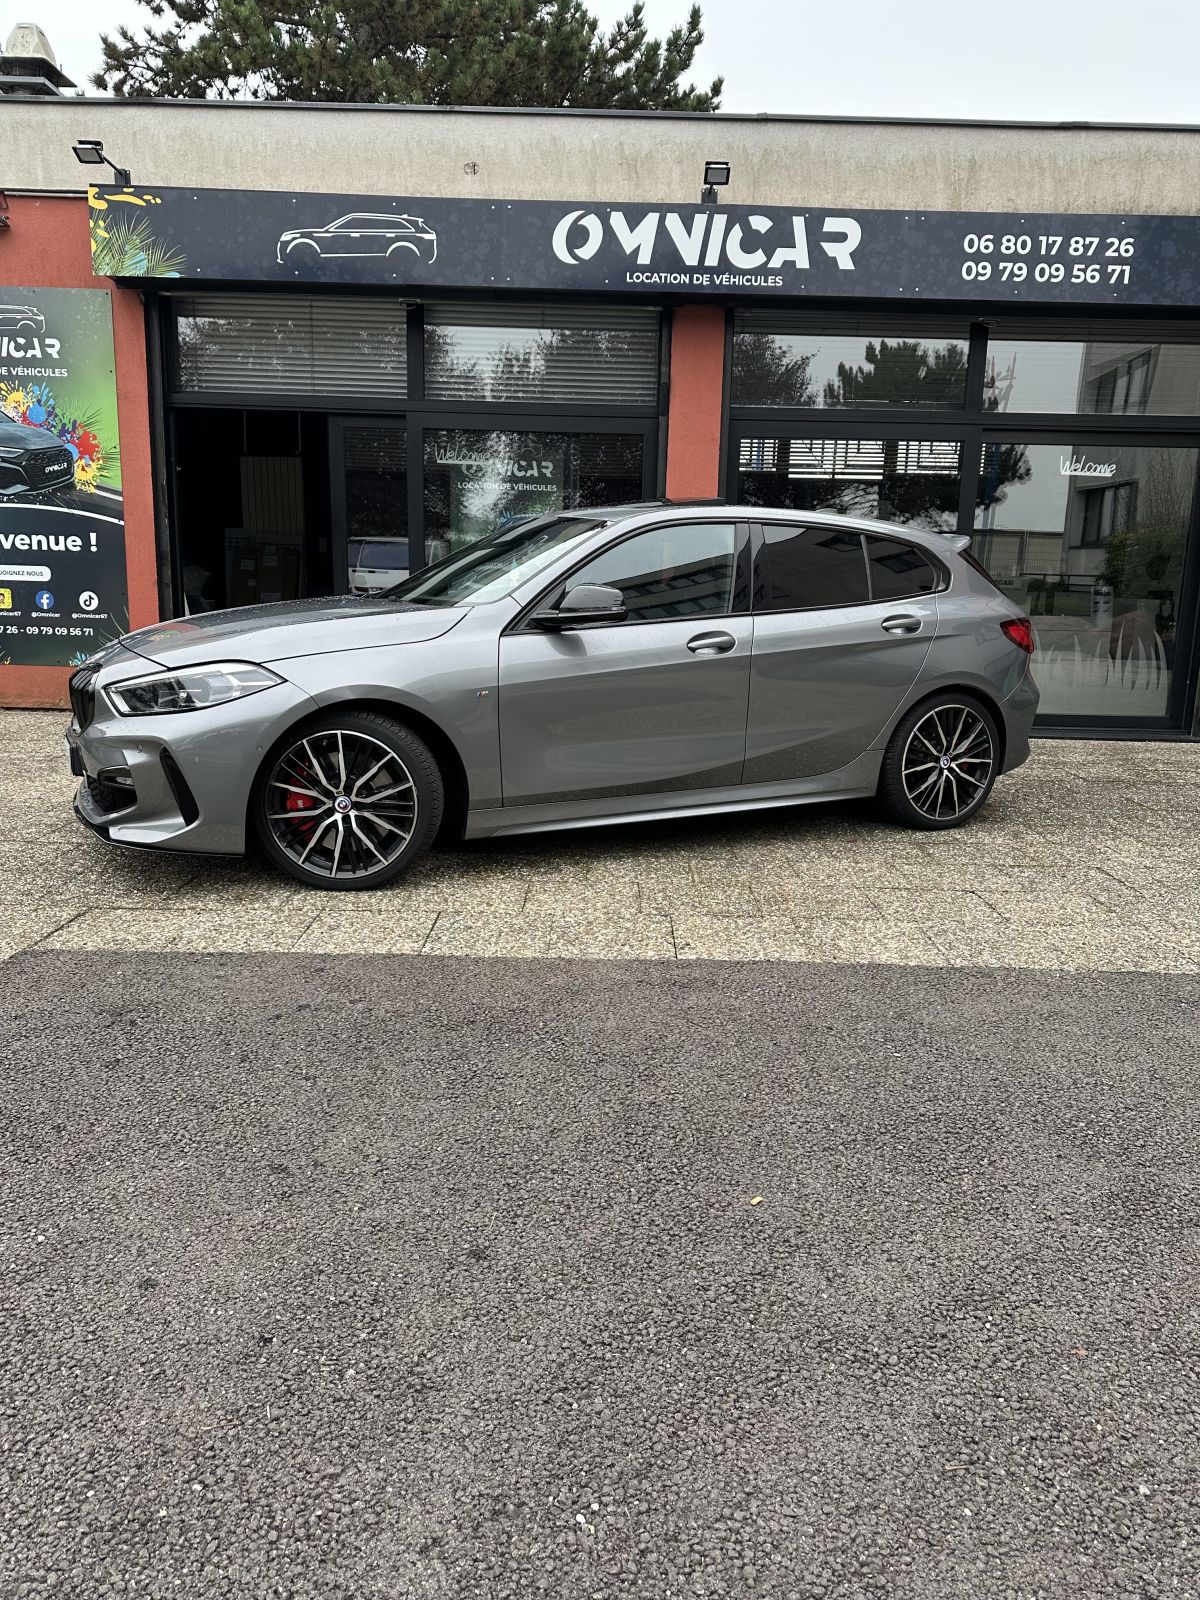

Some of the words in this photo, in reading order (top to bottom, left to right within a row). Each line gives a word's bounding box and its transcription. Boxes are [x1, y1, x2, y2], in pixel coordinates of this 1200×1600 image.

[552, 210, 862, 270] OMNICAR
[963, 233, 994, 254] 06
[1000, 235, 1032, 255] 80
[1038, 236, 1063, 255] 17
[1068, 236, 1100, 256] 87
[1104, 237, 1135, 257] 26
[626, 271, 690, 285] LOCATION
[693, 273, 711, 285] DE
[713, 271, 784, 287] VÉHICULES
[961, 261, 992, 281] 09
[999, 262, 1028, 282] 79
[1034, 263, 1065, 283] 09
[1071, 264, 1101, 284] 56
[1107, 265, 1131, 284] 71
[0, 336, 61, 359] ICAR
[10, 365, 69, 377] VÉHICULES
[435, 442, 493, 465] Welcome
[1060, 455, 1117, 477] Welcome
[500, 482, 512, 491] DE
[513, 481, 558, 493] VÉHICULES
[89, 532, 98, 553] !
[6, 625, 19, 634] 26
[26, 626, 39, 635] 09
[40, 626, 53, 635] 79
[55, 627, 68, 636] 09
[69, 627, 82, 636] 56
[83, 627, 94, 636] 71
